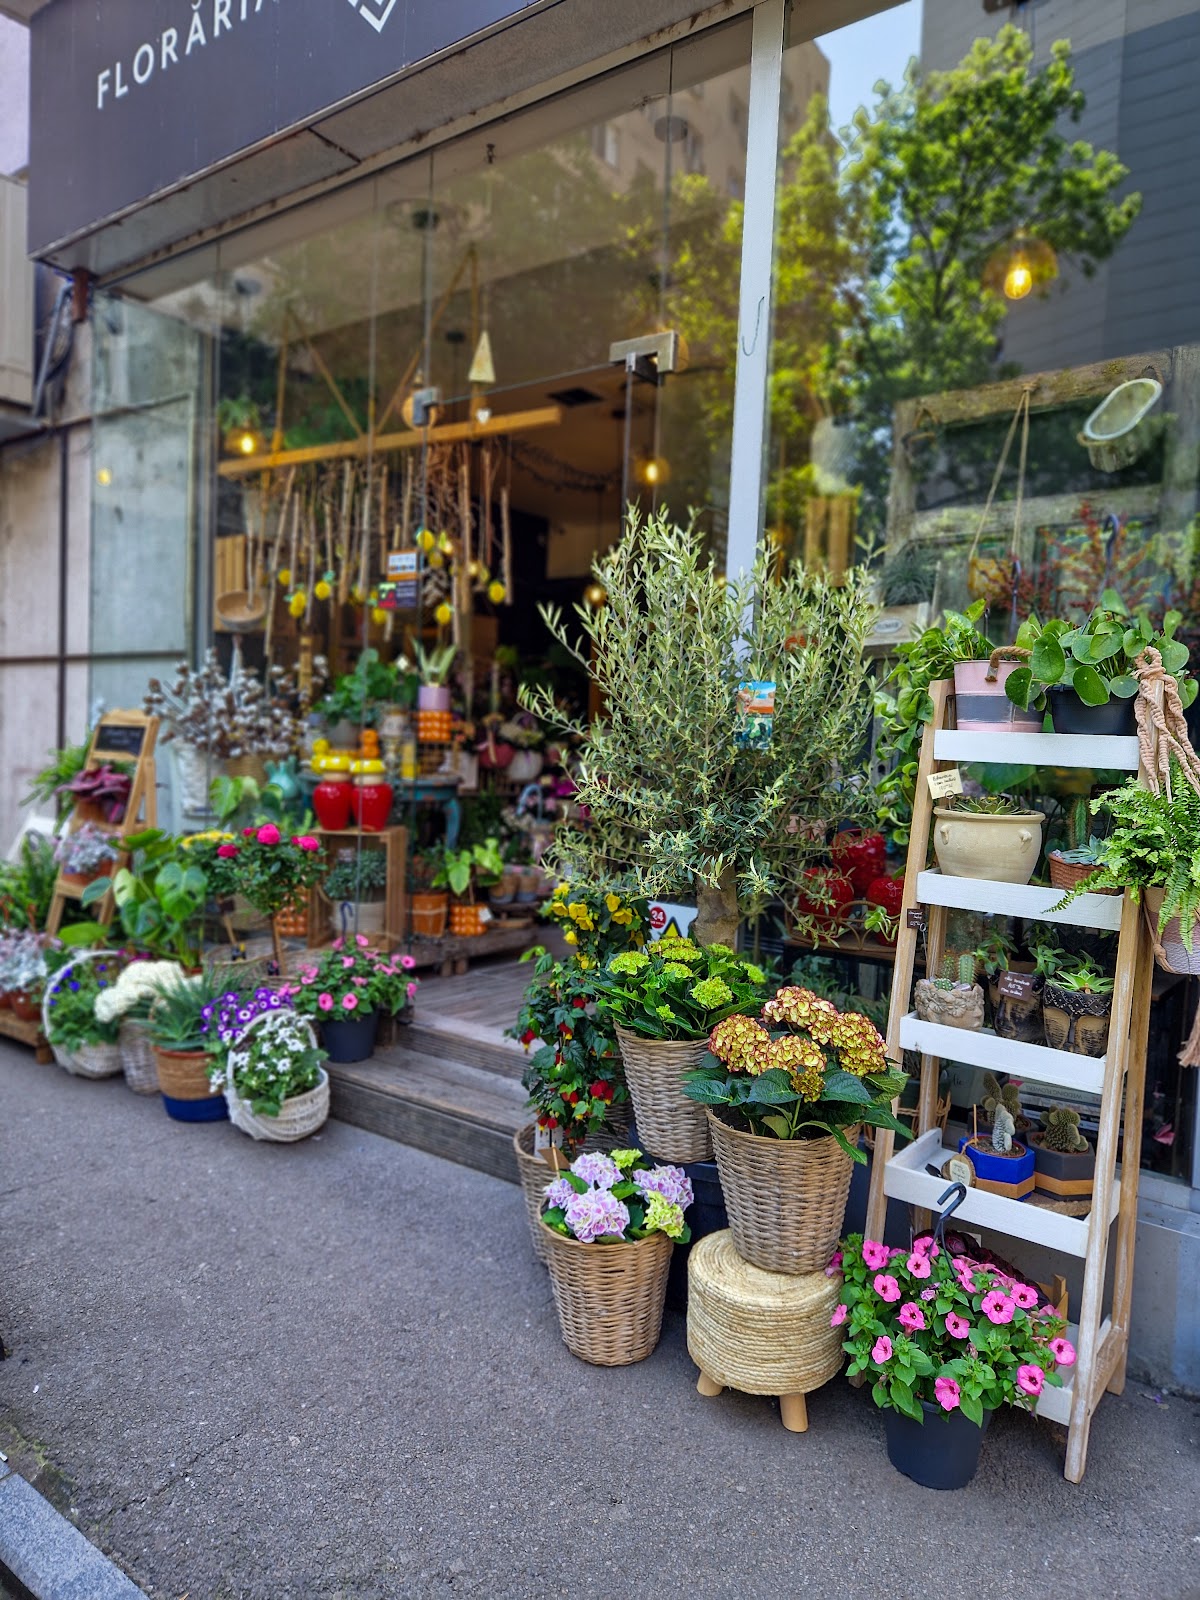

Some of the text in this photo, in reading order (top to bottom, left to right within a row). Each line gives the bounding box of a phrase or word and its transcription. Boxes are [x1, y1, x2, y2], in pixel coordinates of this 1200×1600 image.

[97, 0, 263, 109] FLORĂRI
[651, 910, 664, 921] 24
[1025, 1085, 1052, 1096] FLOWERS
[1052, 1089, 1083, 1100] WEDDING
